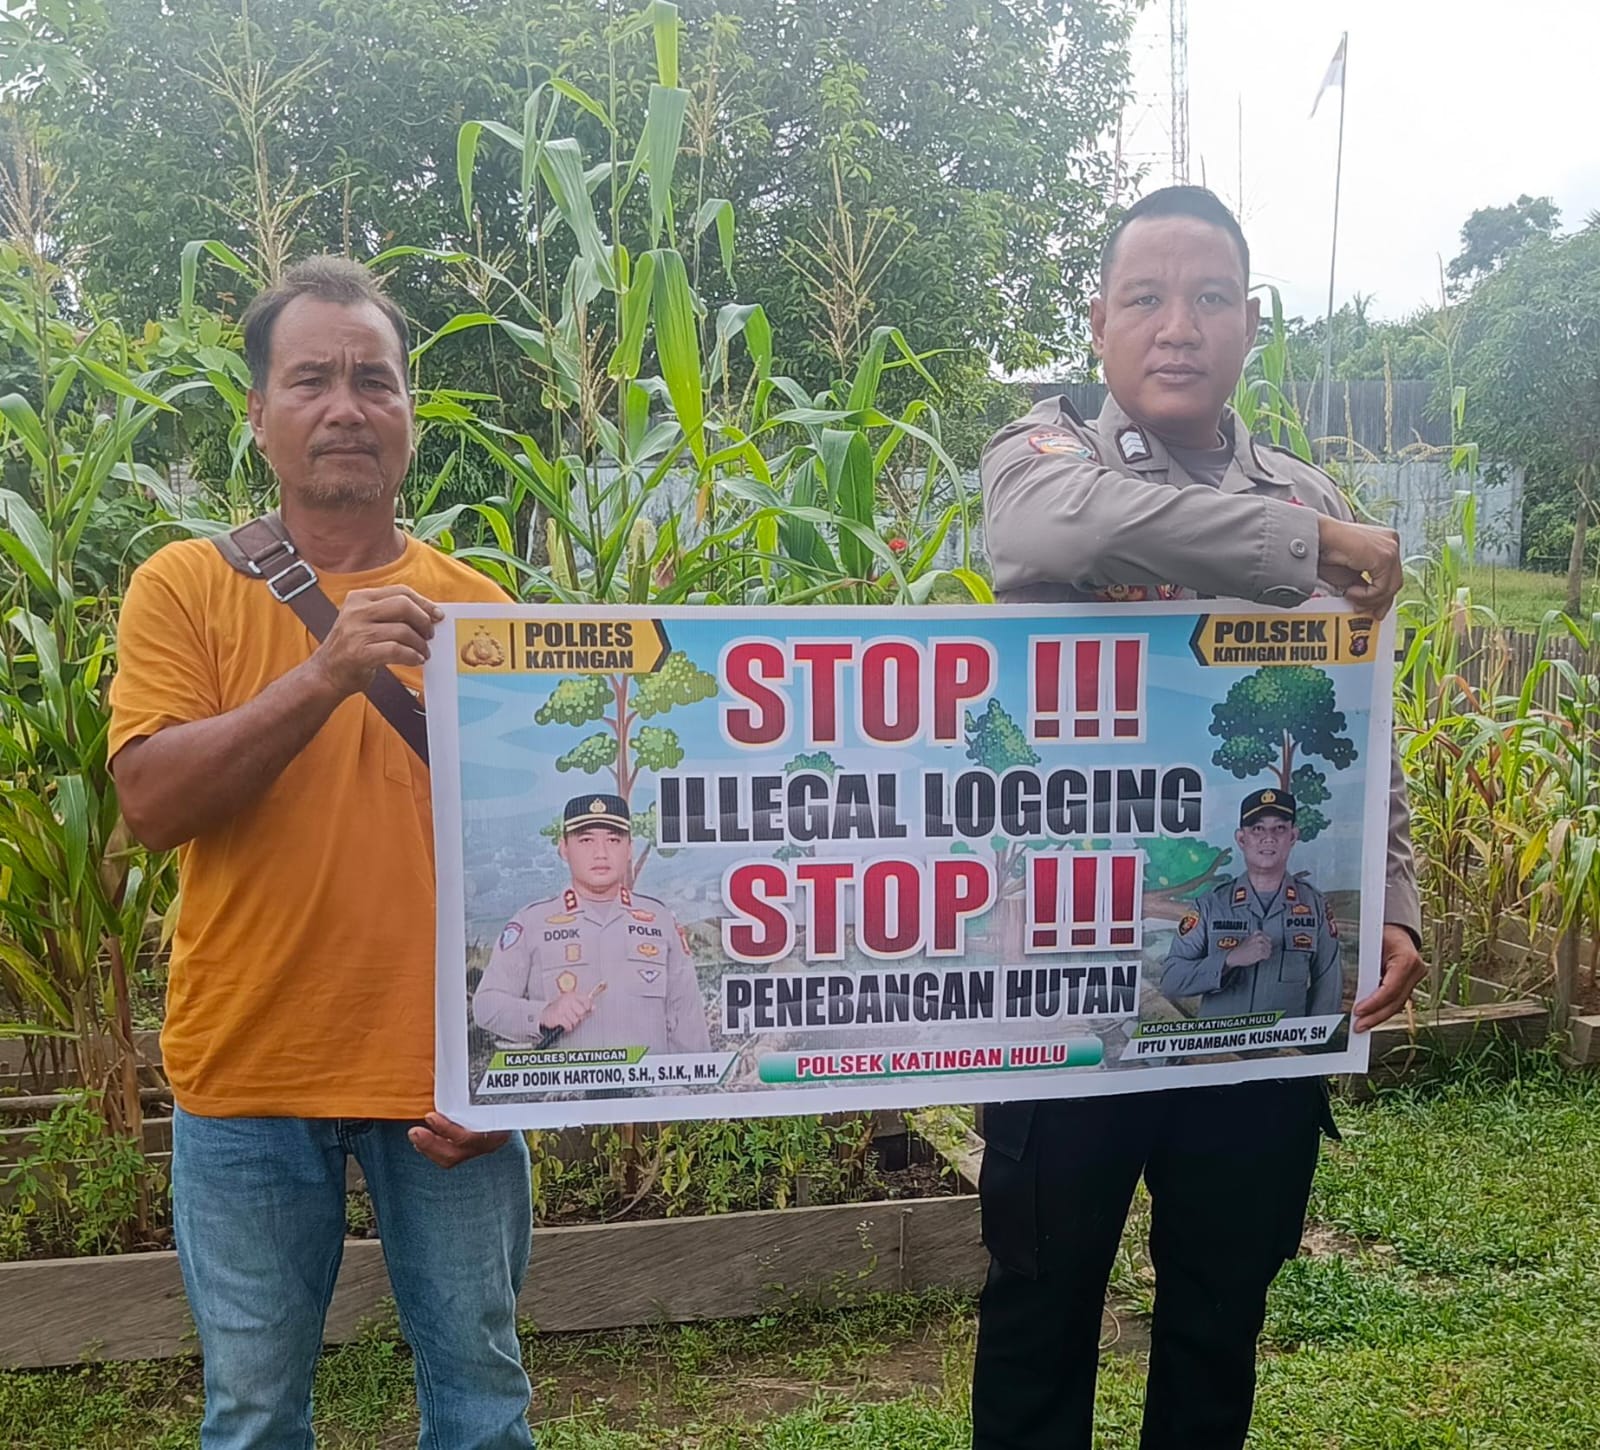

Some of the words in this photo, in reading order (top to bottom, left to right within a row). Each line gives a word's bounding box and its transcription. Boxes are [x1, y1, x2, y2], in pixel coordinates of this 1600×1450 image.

[525, 622, 632, 647] POLRES
[1214, 620, 1327, 644] POLSEK
[525, 650, 633, 669] KATINGAN
[1213, 646, 1286, 662] KATINGAN
[1289, 646, 1327, 661] HULU
[725, 641, 991, 745] STOP
[1033, 640, 1141, 738] !!!
[660, 773, 907, 843] ILLEGAL
[924, 767, 1202, 838] LOGGING
[730, 860, 990, 957] STOP
[1032, 856, 1135, 947] !!!
[544, 929, 580, 941] DODIK
[628, 925, 662, 937] POLRI
[726, 970, 994, 1029] PENEBANGAN
[1005, 966, 1137, 1018] HUTAN
[1142, 1023, 1195, 1034] KAPOLSEK
[1198, 1018, 1246, 1030] KATINGAN
[1249, 1015, 1274, 1024] HULU
[1137, 1039, 1166, 1054] IPTU
[1169, 1034, 1246, 1050] YUBAMBANG
[1249, 1028, 1307, 1045] KUSNADY,
[1311, 1026, 1326, 1040] SH
[506, 1054, 565, 1066] KAPOLRES
[568, 1051, 626, 1063] KATINGAN
[798, 1055, 883, 1076] POLSEK
[891, 1050, 1000, 1071] KATINGAN
[1010, 1045, 1066, 1065] HULU
[487, 1072, 519, 1088] AKBP
[523, 1071, 560, 1086] DODIK
[564, 1069, 625, 1084] HARTONO,
[628, 1067, 655, 1083] S.H.,
[658, 1066, 691, 1081] S.I.K.,
[694, 1064, 719, 1079] M.H.
